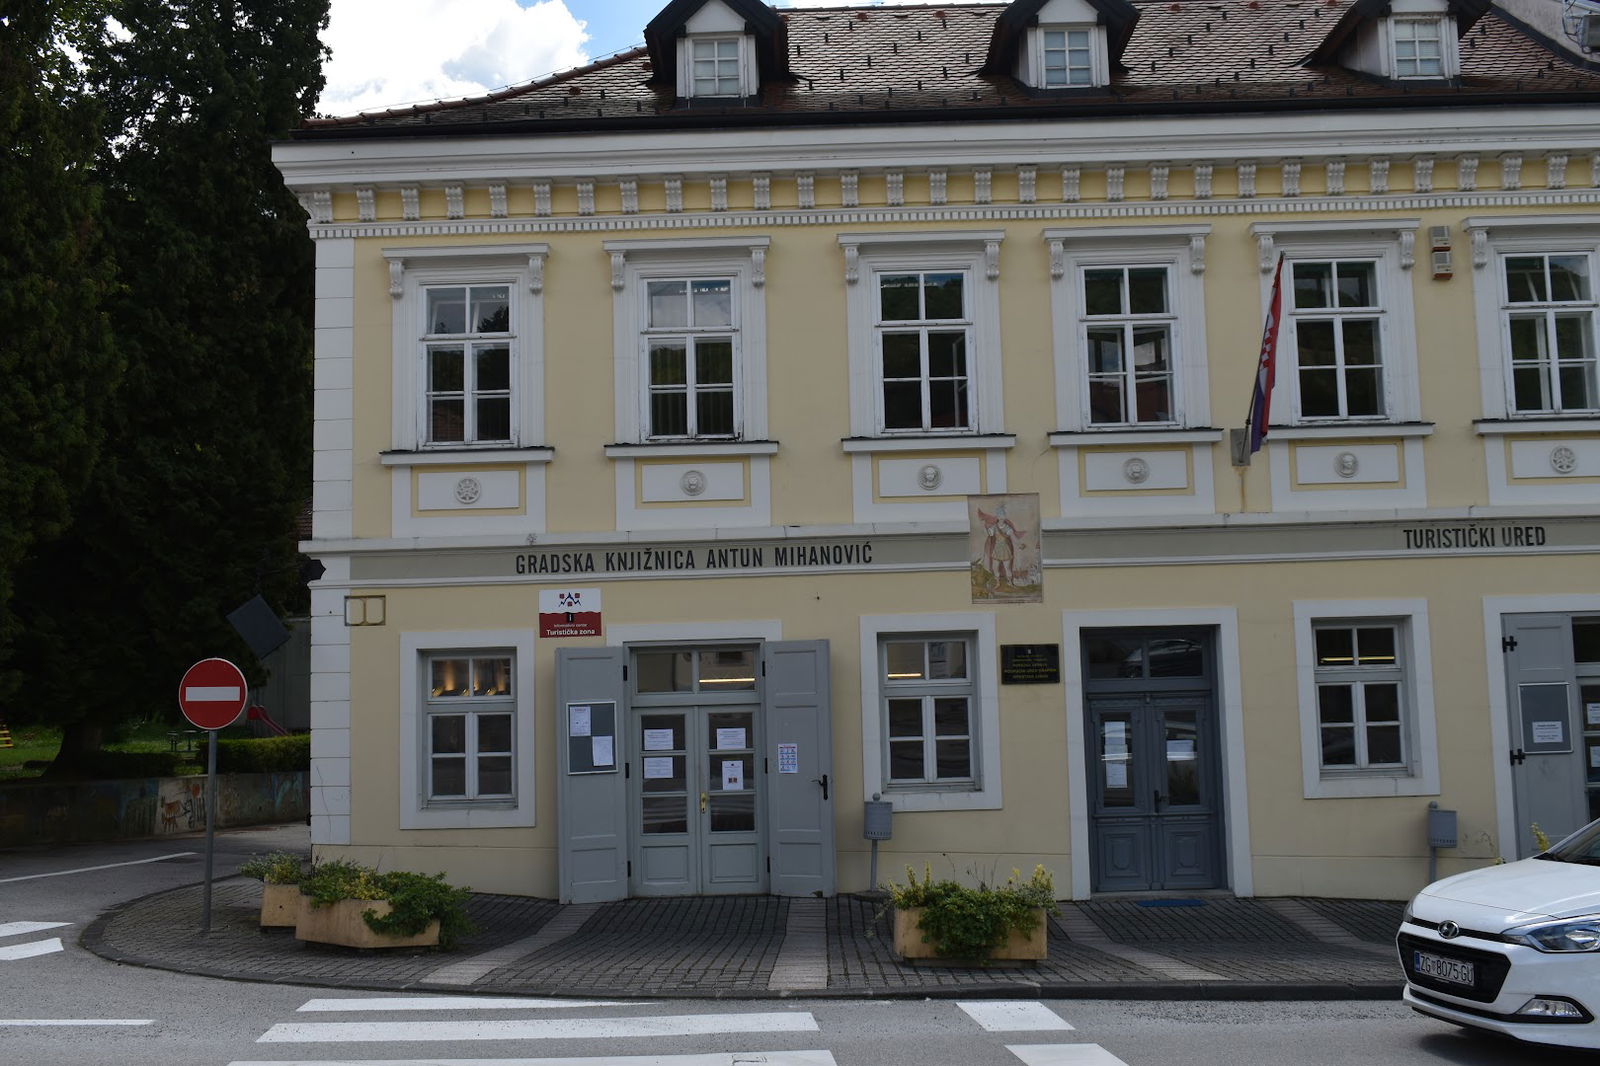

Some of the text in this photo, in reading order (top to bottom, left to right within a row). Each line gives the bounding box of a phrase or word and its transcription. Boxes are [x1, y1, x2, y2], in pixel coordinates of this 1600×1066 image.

[1403, 524, 1546, 549] TURISTIČKI URED
[516, 542, 873, 574] GRADSKA KNJIŽNICA ANTUN MIHANOVIĆ
[1420, 955, 1431, 973] ZG
